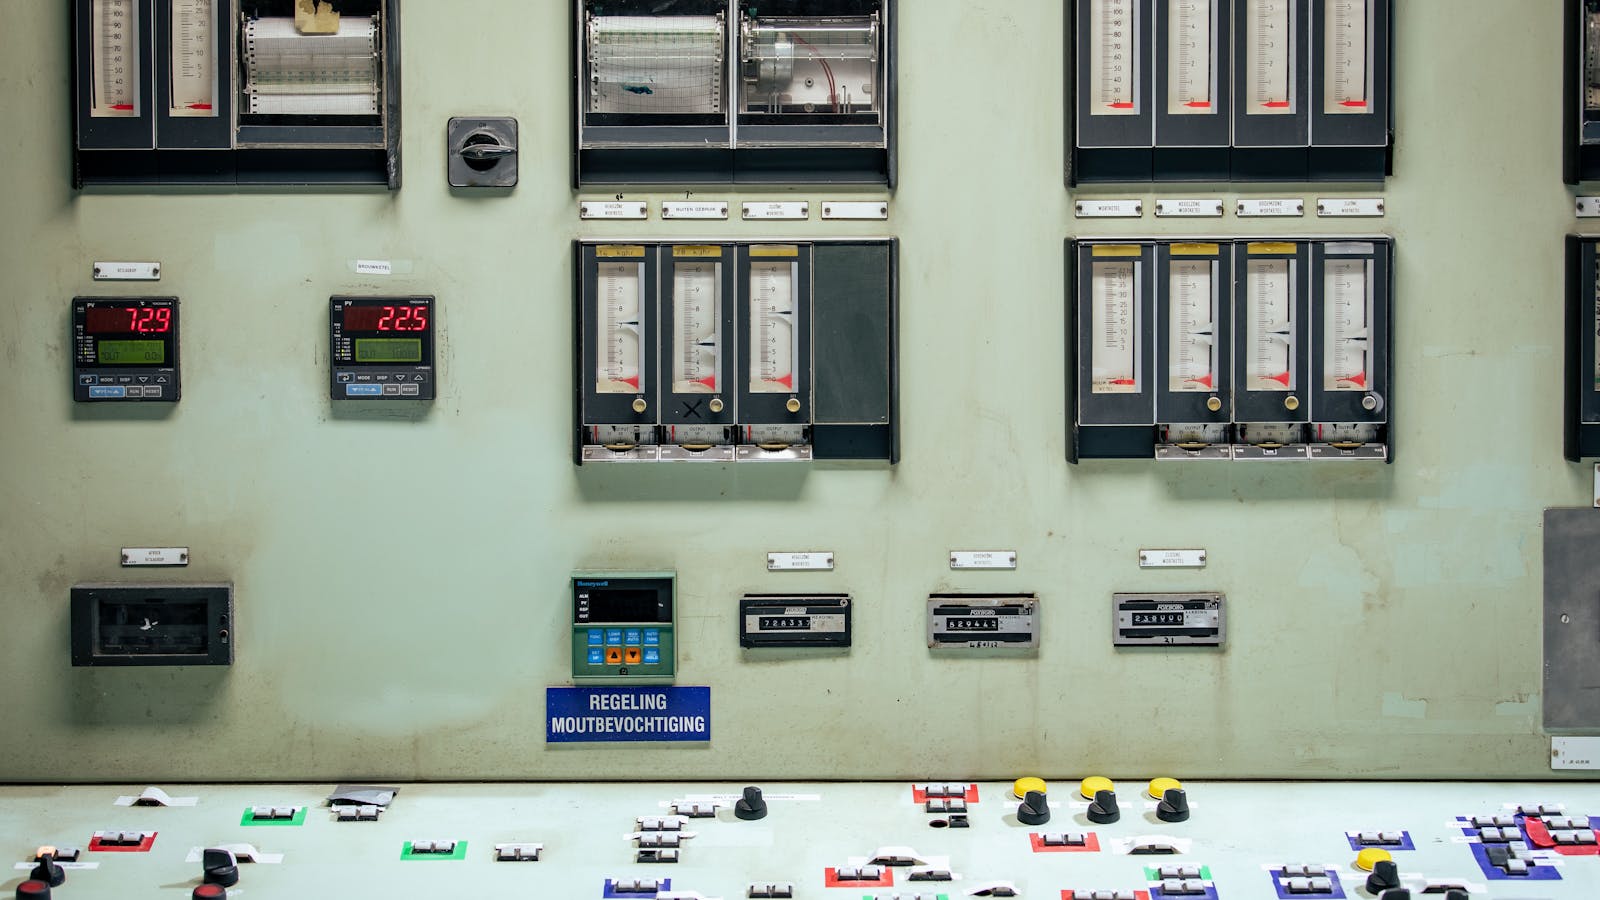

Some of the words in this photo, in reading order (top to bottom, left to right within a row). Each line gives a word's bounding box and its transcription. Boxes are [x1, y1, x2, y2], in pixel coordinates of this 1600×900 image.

[126, 308, 171, 332] 72.9
[378, 306, 426, 330] 22.5
[590, 694, 666, 710] REGELING
[552, 716, 704, 733] MOUTBEVOCHTIGING
